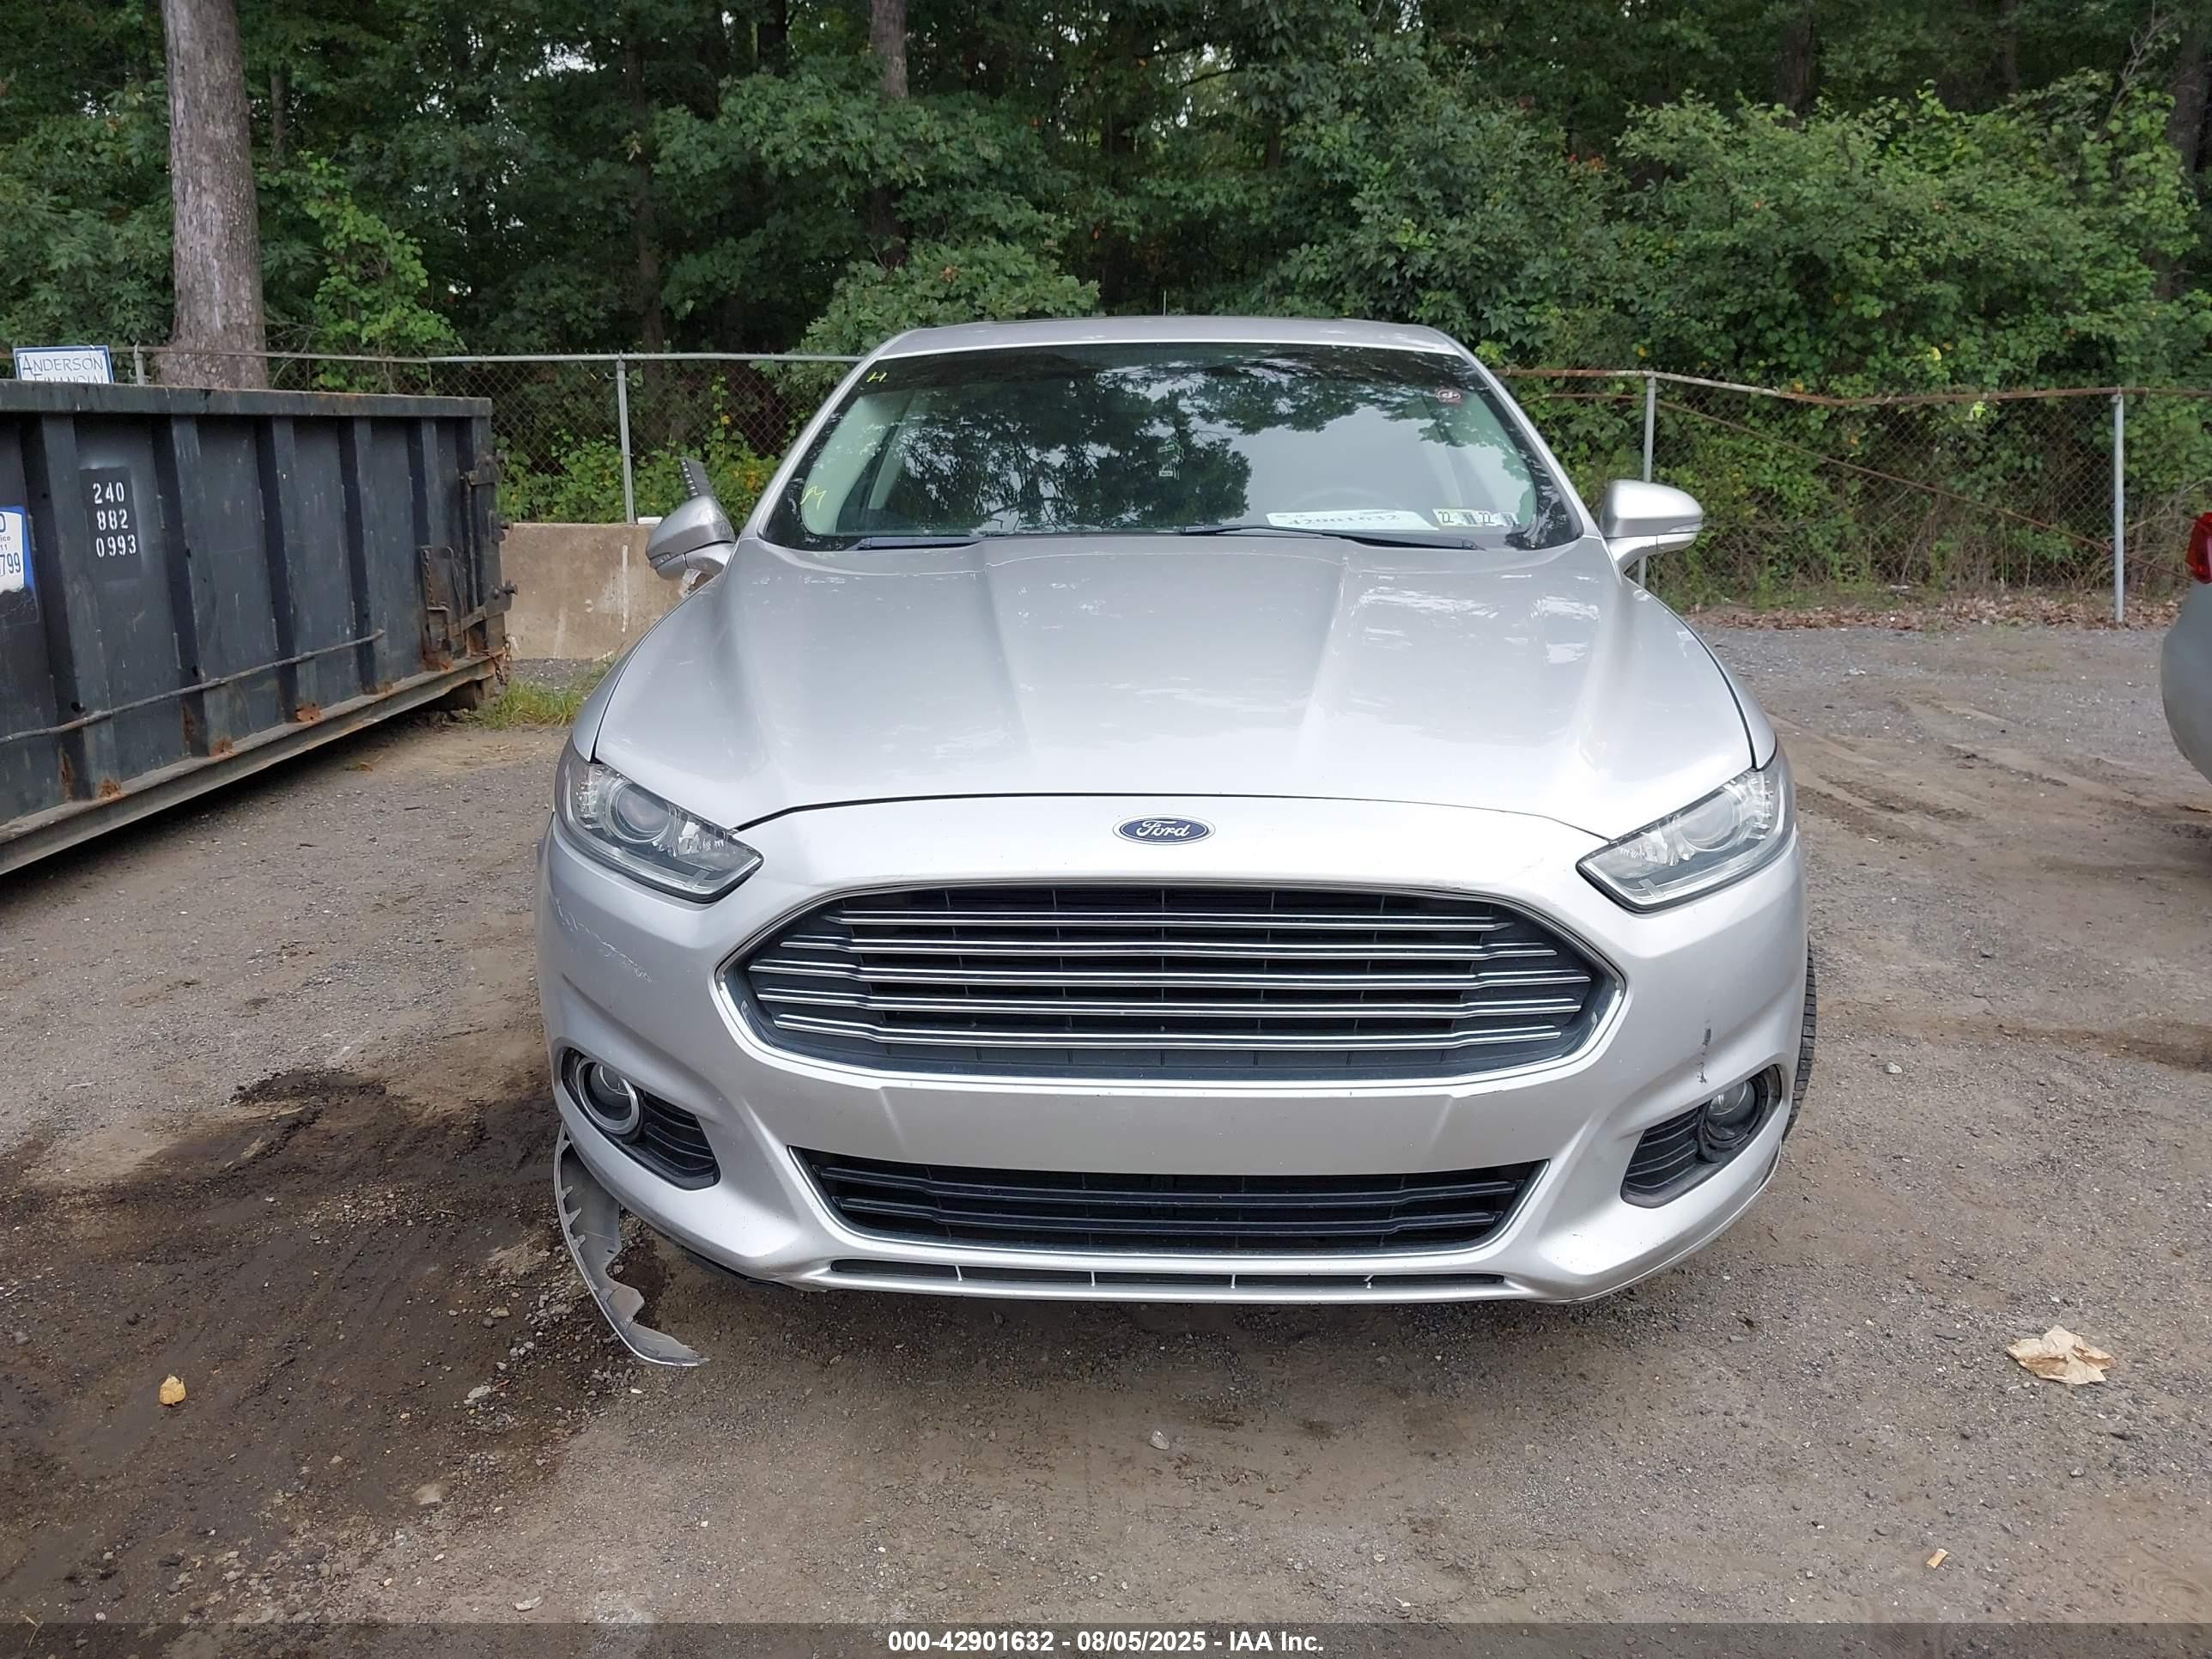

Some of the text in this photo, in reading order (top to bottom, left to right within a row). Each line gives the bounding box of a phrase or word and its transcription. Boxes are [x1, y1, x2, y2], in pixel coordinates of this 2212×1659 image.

[22, 355, 103, 374] ANDERSON
[93, 482, 125, 504] 240
[96, 508, 128, 531] 882
[96, 534, 137, 558] 0993
[1135, 819, 1190, 837] Ford
